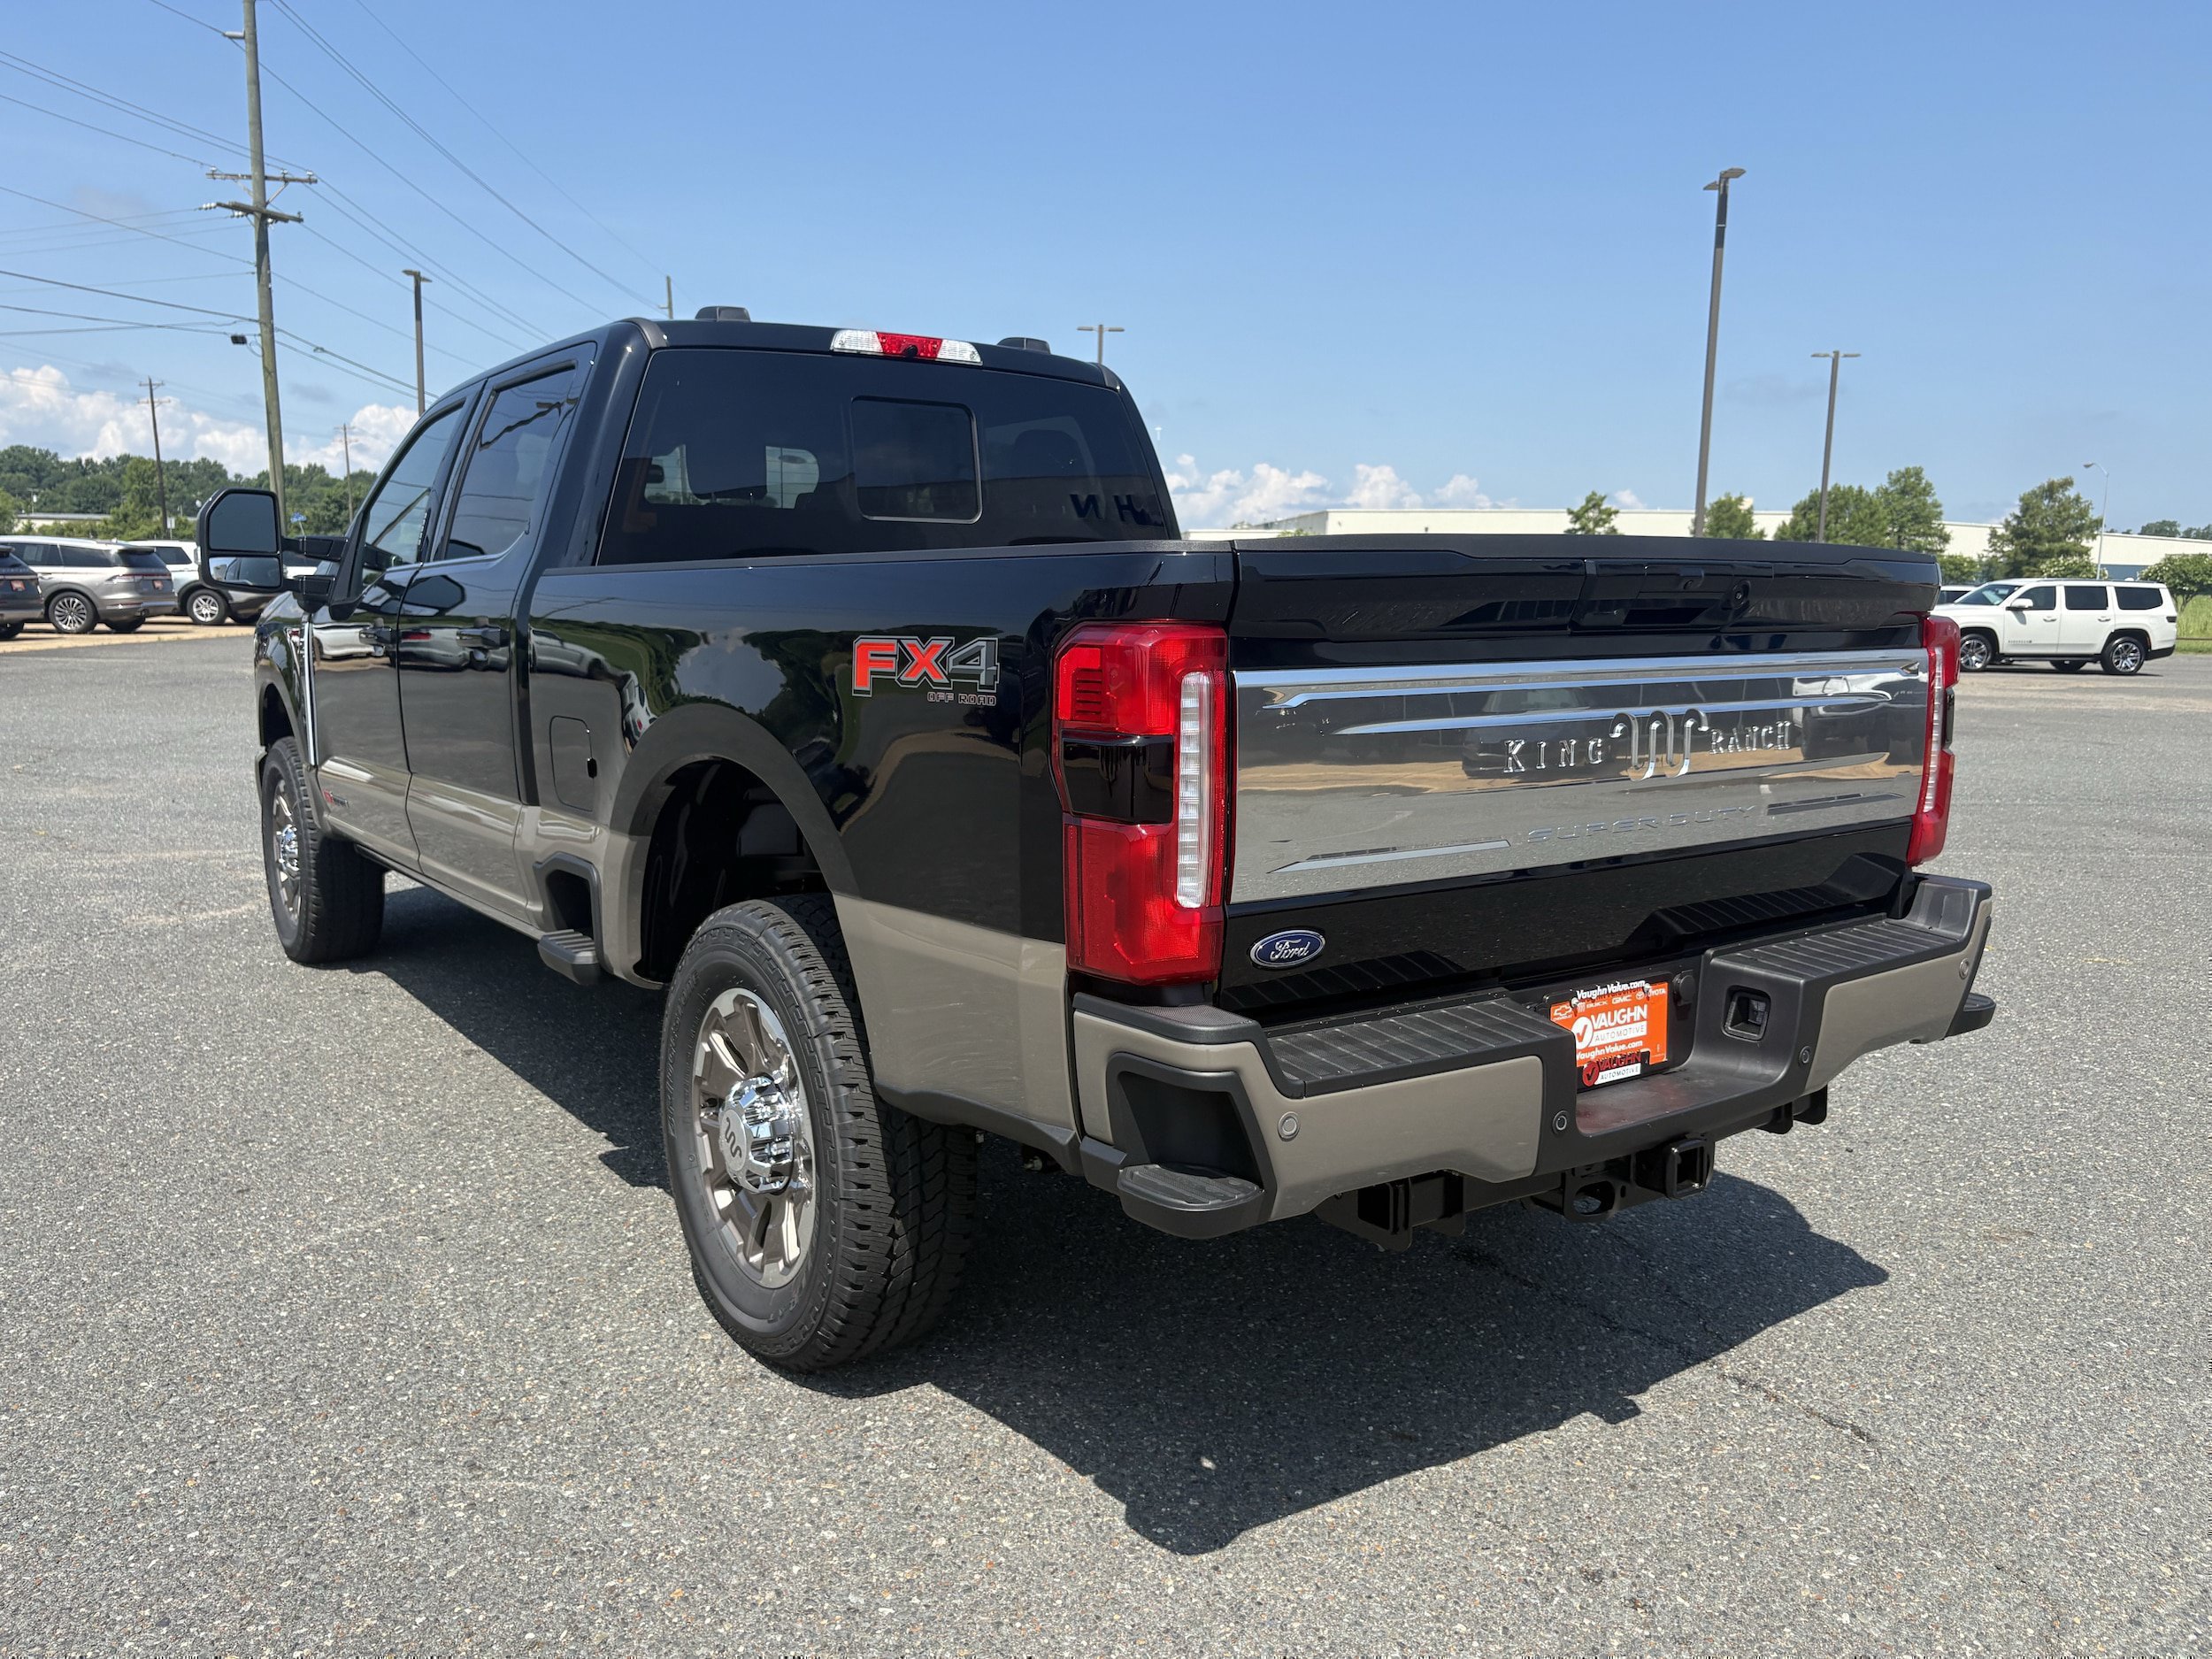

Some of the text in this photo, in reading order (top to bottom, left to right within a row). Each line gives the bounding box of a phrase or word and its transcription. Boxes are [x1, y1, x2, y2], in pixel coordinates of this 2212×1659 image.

[852, 634, 1000, 697] FX4
[927, 691, 996, 706] OFF ROAD
[1503, 721, 1792, 772] KING RANCH
[1527, 816, 1658, 841] SUPER
[1270, 938, 1311, 962] Ford
[1576, 979, 1646, 1001] VaughnValue.com
[1611, 994, 1632, 1004] GMC
[1647, 987, 1666, 997] OYOTA
[1590, 1003, 1648, 1029] VAUGHN
[1594, 1025, 1645, 1042] AUTOMOTIVE
[1598, 1050, 1642, 1071] VAUGHN
[1600, 1065, 1639, 1080] AUTOMOTIVE
